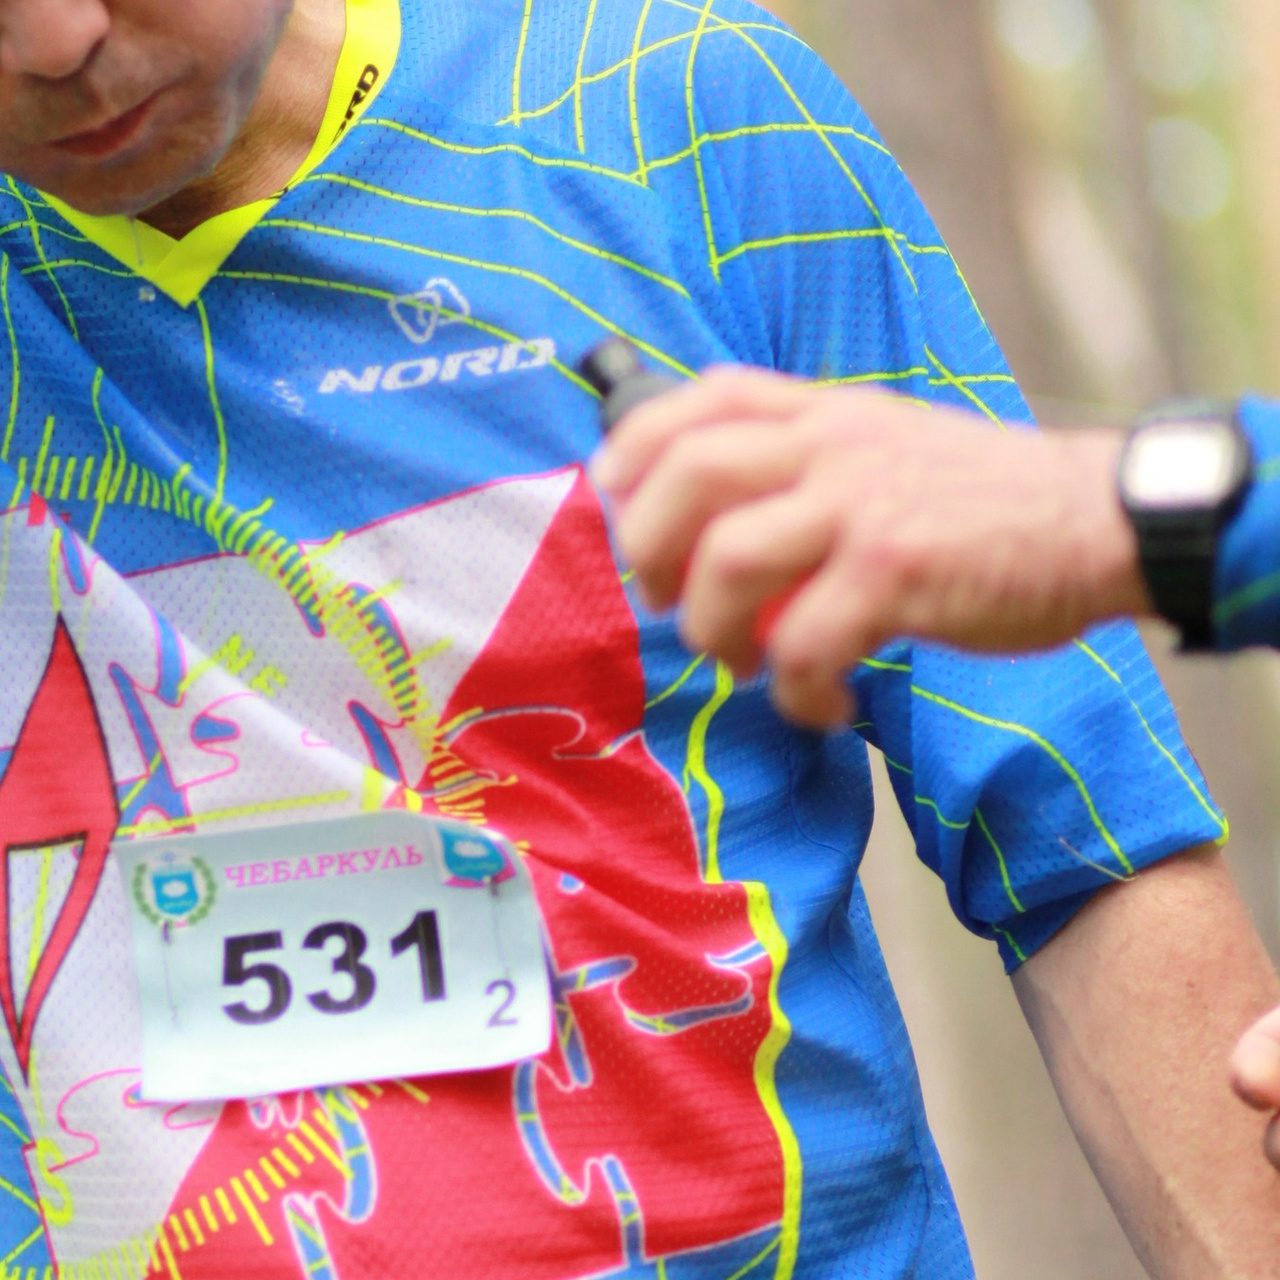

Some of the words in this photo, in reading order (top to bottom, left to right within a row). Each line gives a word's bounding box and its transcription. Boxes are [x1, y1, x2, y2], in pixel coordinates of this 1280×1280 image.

[319, 337, 556, 395] NORD
[224, 844, 424, 888] ЧЕБАРКУЛЬ
[221, 907, 447, 1026] 531
[484, 978, 518, 1028] 2
